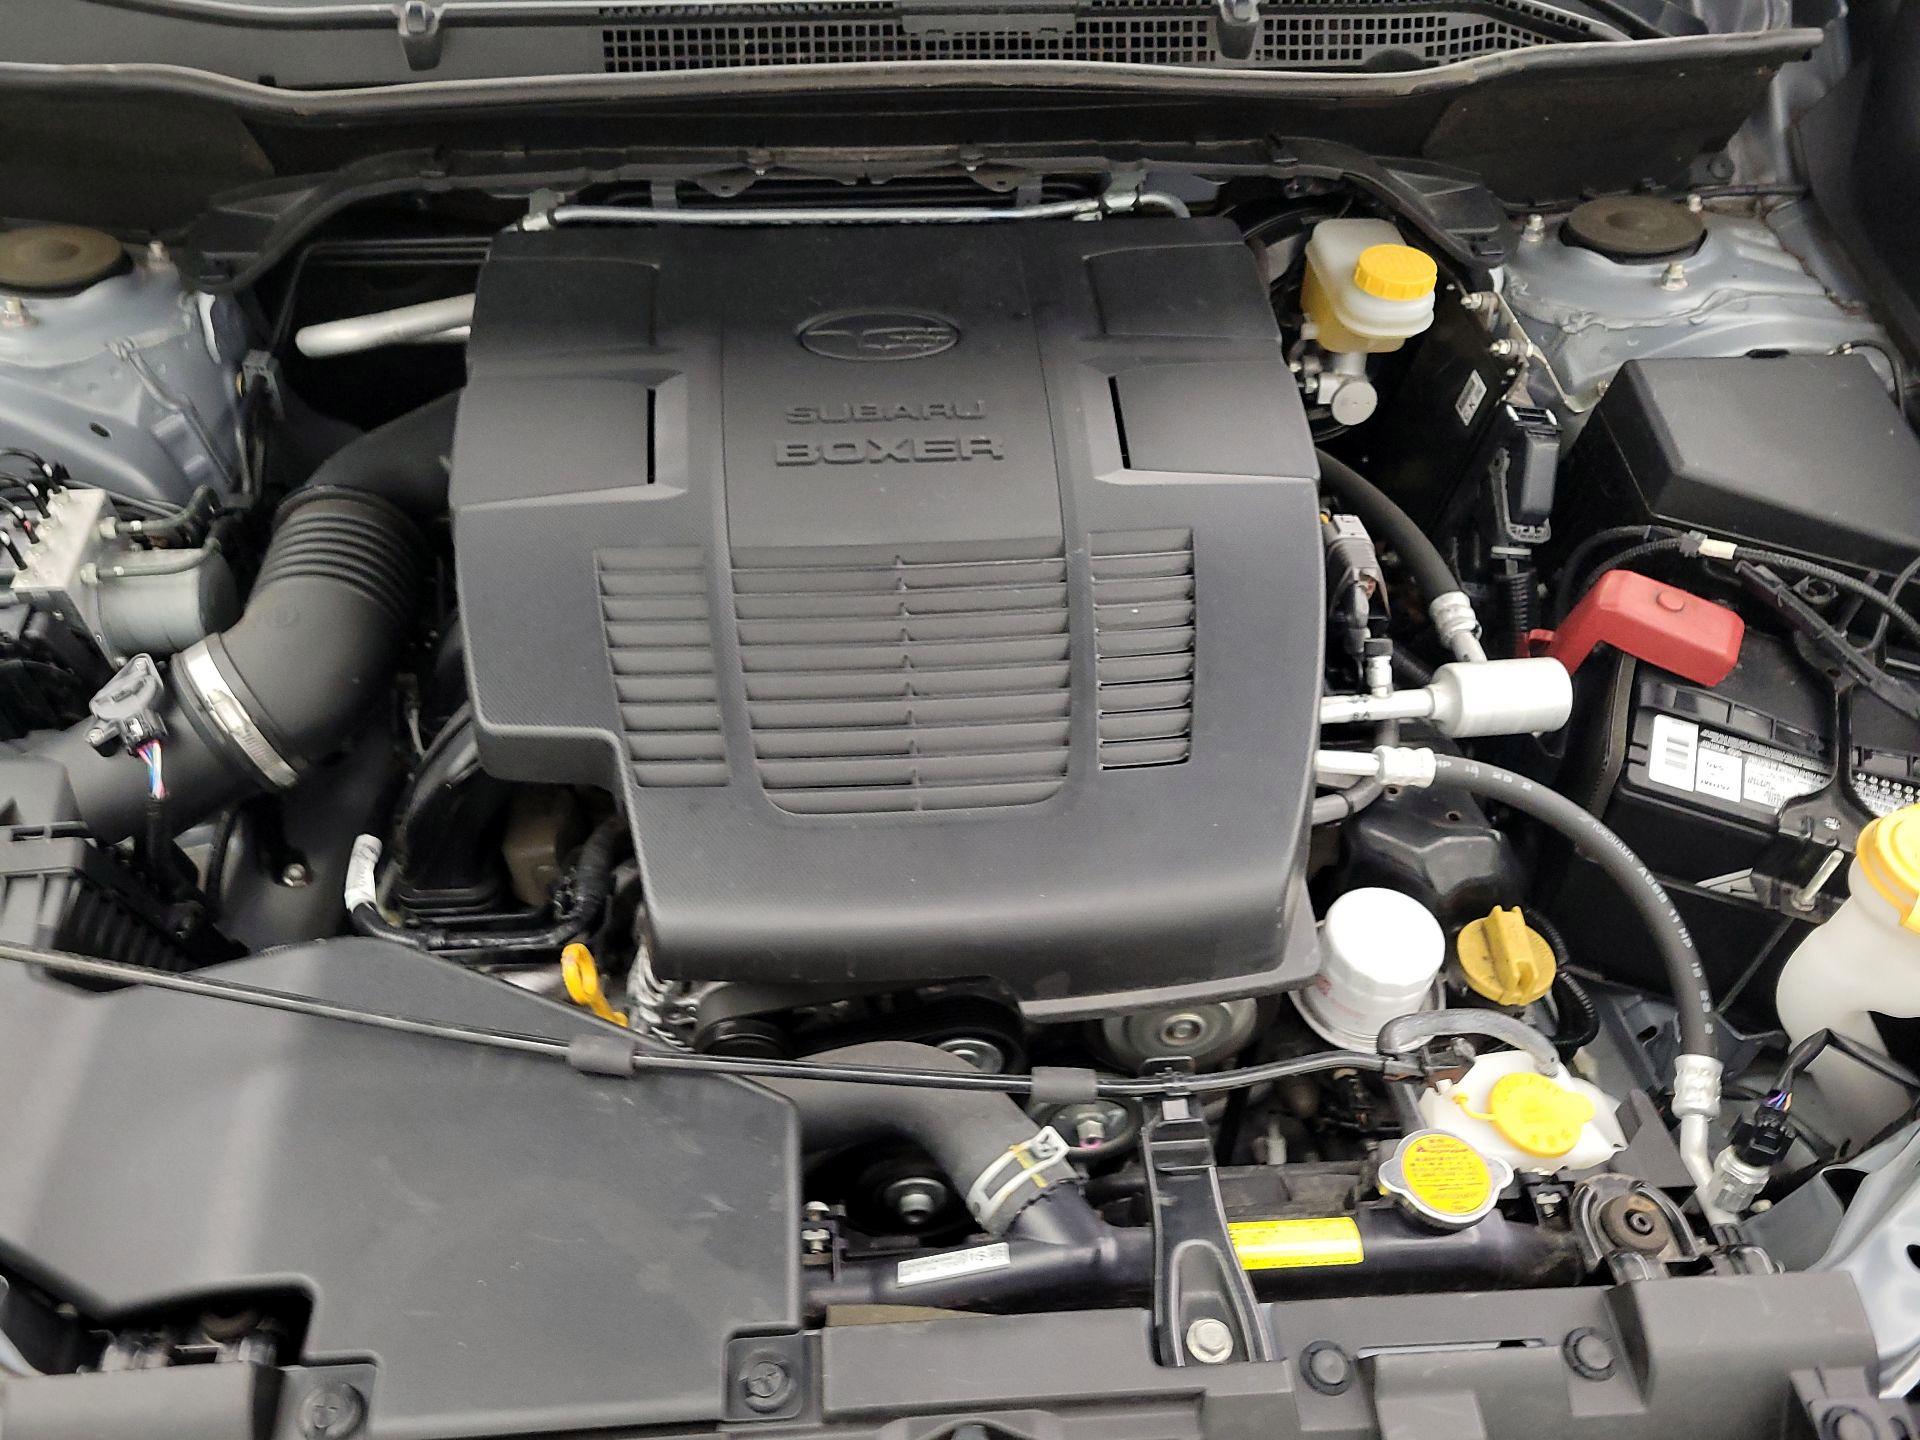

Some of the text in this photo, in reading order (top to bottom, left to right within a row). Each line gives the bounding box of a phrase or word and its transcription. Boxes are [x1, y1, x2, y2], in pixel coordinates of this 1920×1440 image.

[785, 400, 986, 424] SUBARU
[775, 437, 1005, 467] BOXER
[1592, 822, 1635, 862] YOKOHAMA
